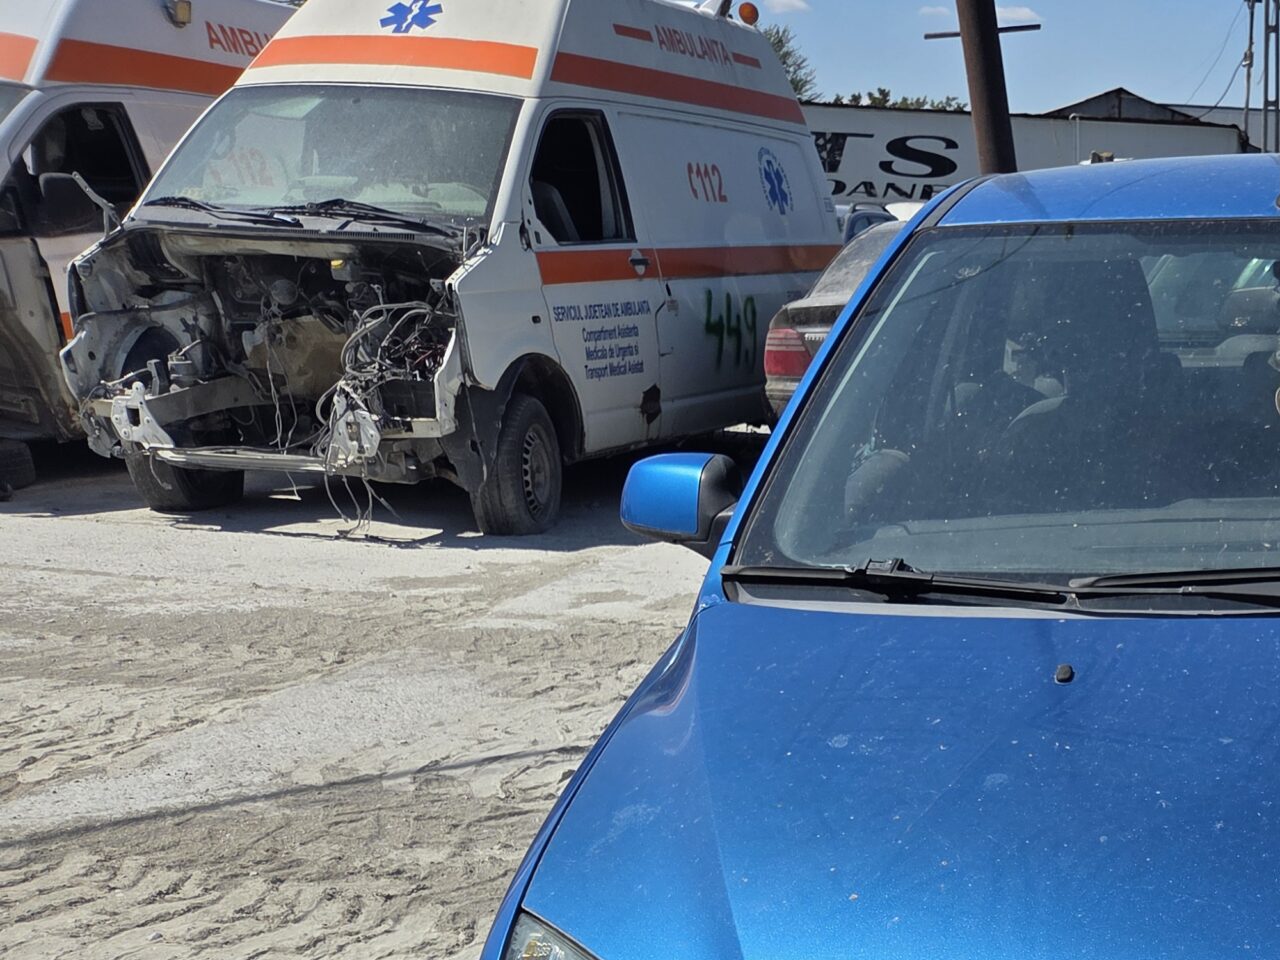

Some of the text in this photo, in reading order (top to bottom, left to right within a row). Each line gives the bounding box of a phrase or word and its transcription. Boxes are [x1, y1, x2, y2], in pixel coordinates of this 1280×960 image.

[655, 24, 733, 67] AMBULANTA
[696, 162, 728, 203] 112
[612, 302, 620, 318] DE
[621, 300, 651, 316] AMBULANTA
[704, 288, 757, 375] 449
[584, 364, 608, 381] Transport
[608, 360, 628, 377] Medical
